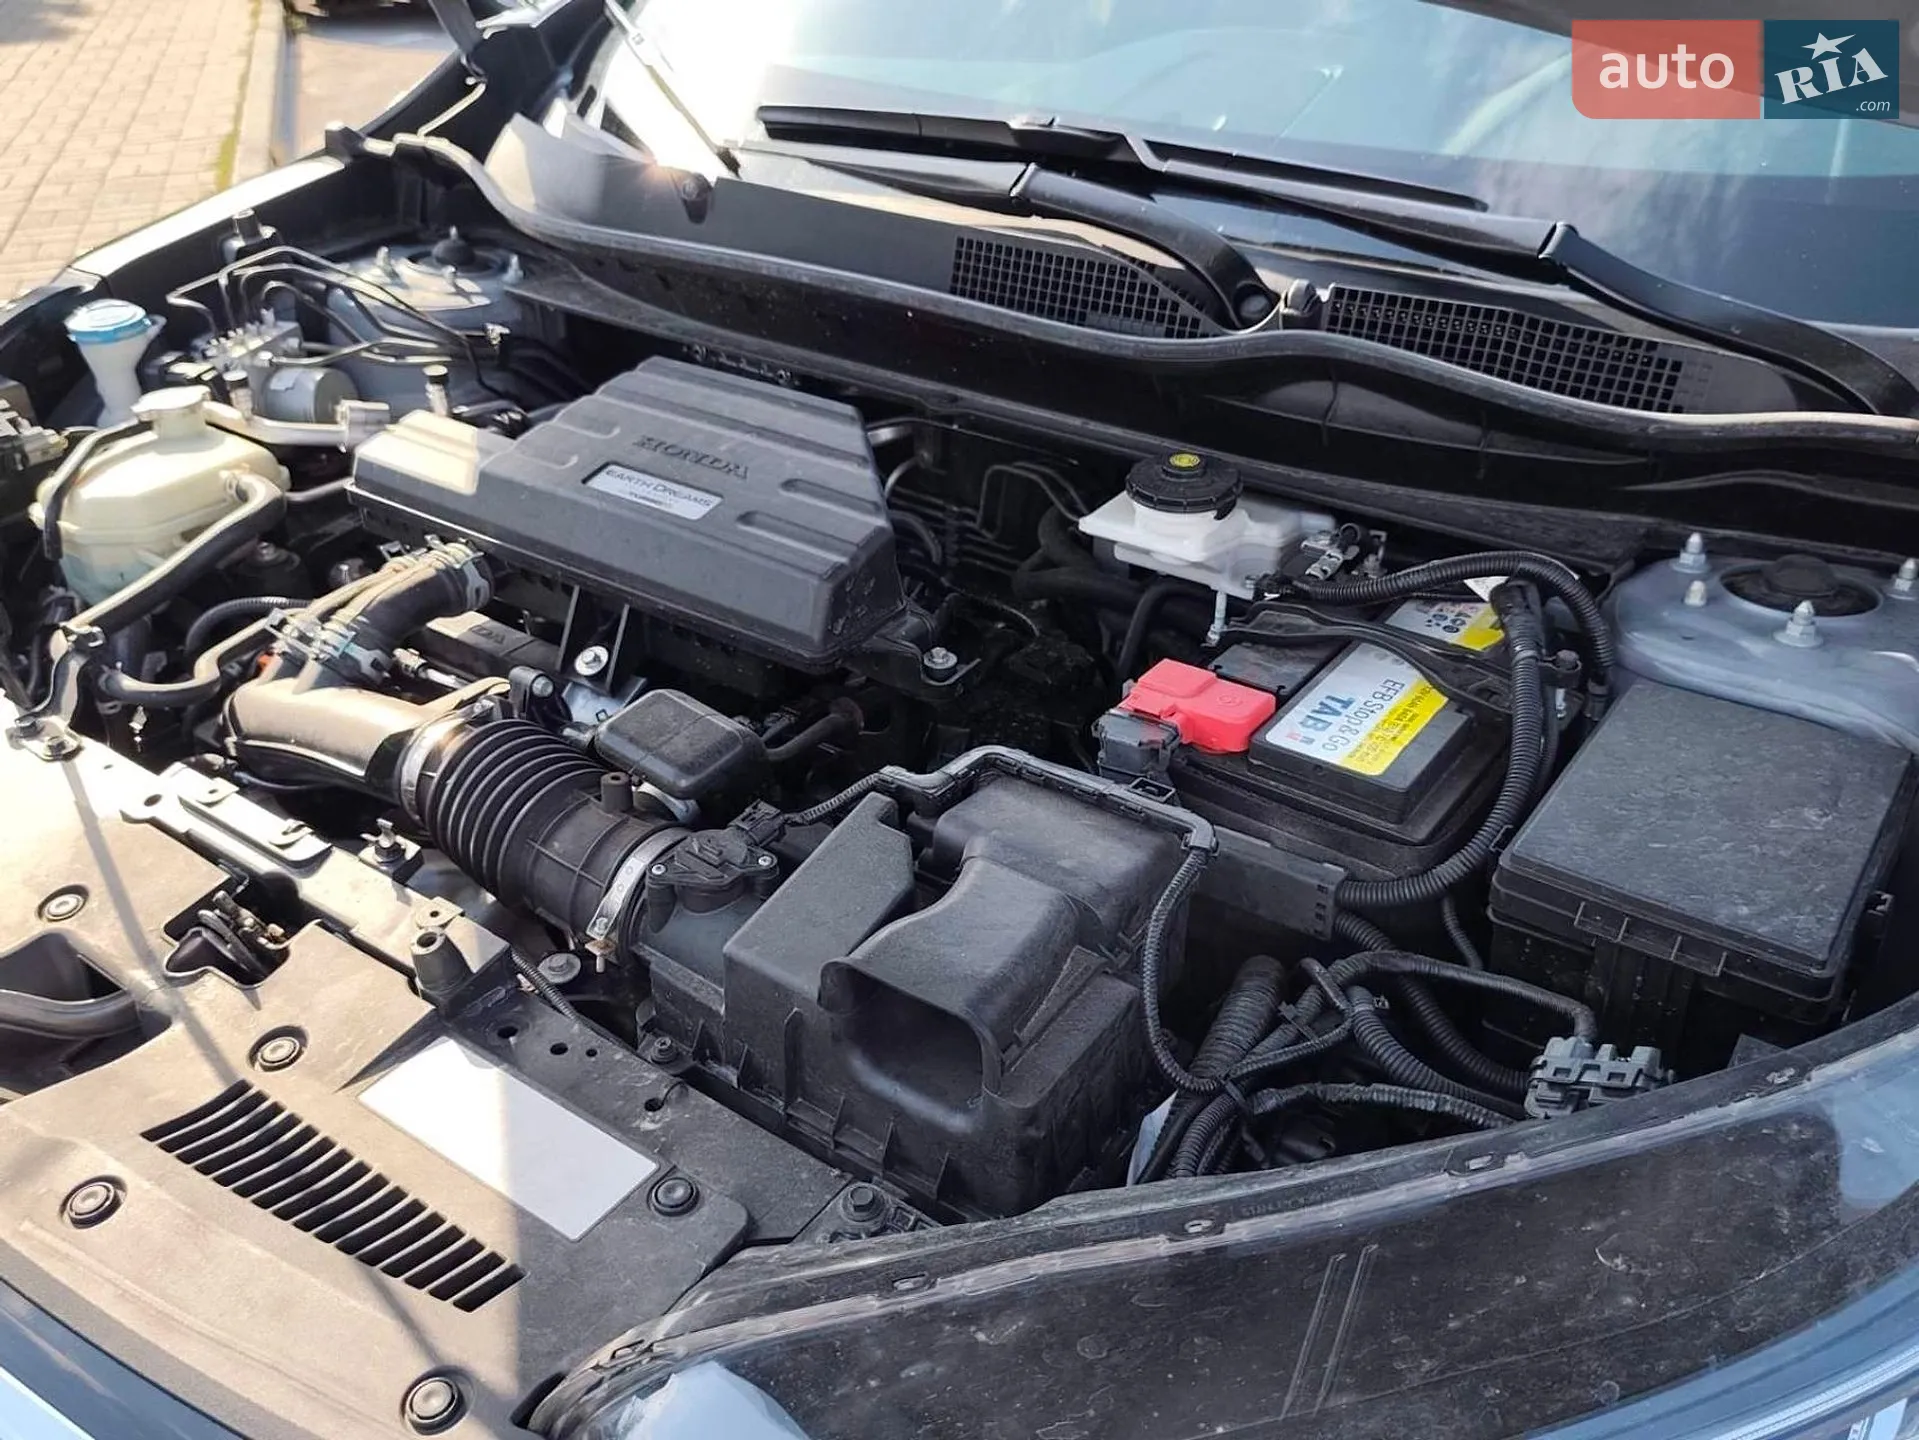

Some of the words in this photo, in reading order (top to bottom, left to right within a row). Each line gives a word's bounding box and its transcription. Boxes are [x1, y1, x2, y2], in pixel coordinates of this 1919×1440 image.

[633, 434, 748, 480] HONDA
[605, 468, 655, 490] EARTH
[1372, 678, 1406, 702] EFB
[1298, 695, 1356, 732] TAB
[1345, 700, 1384, 725] Stop
[1321, 734, 1351, 751] Go
